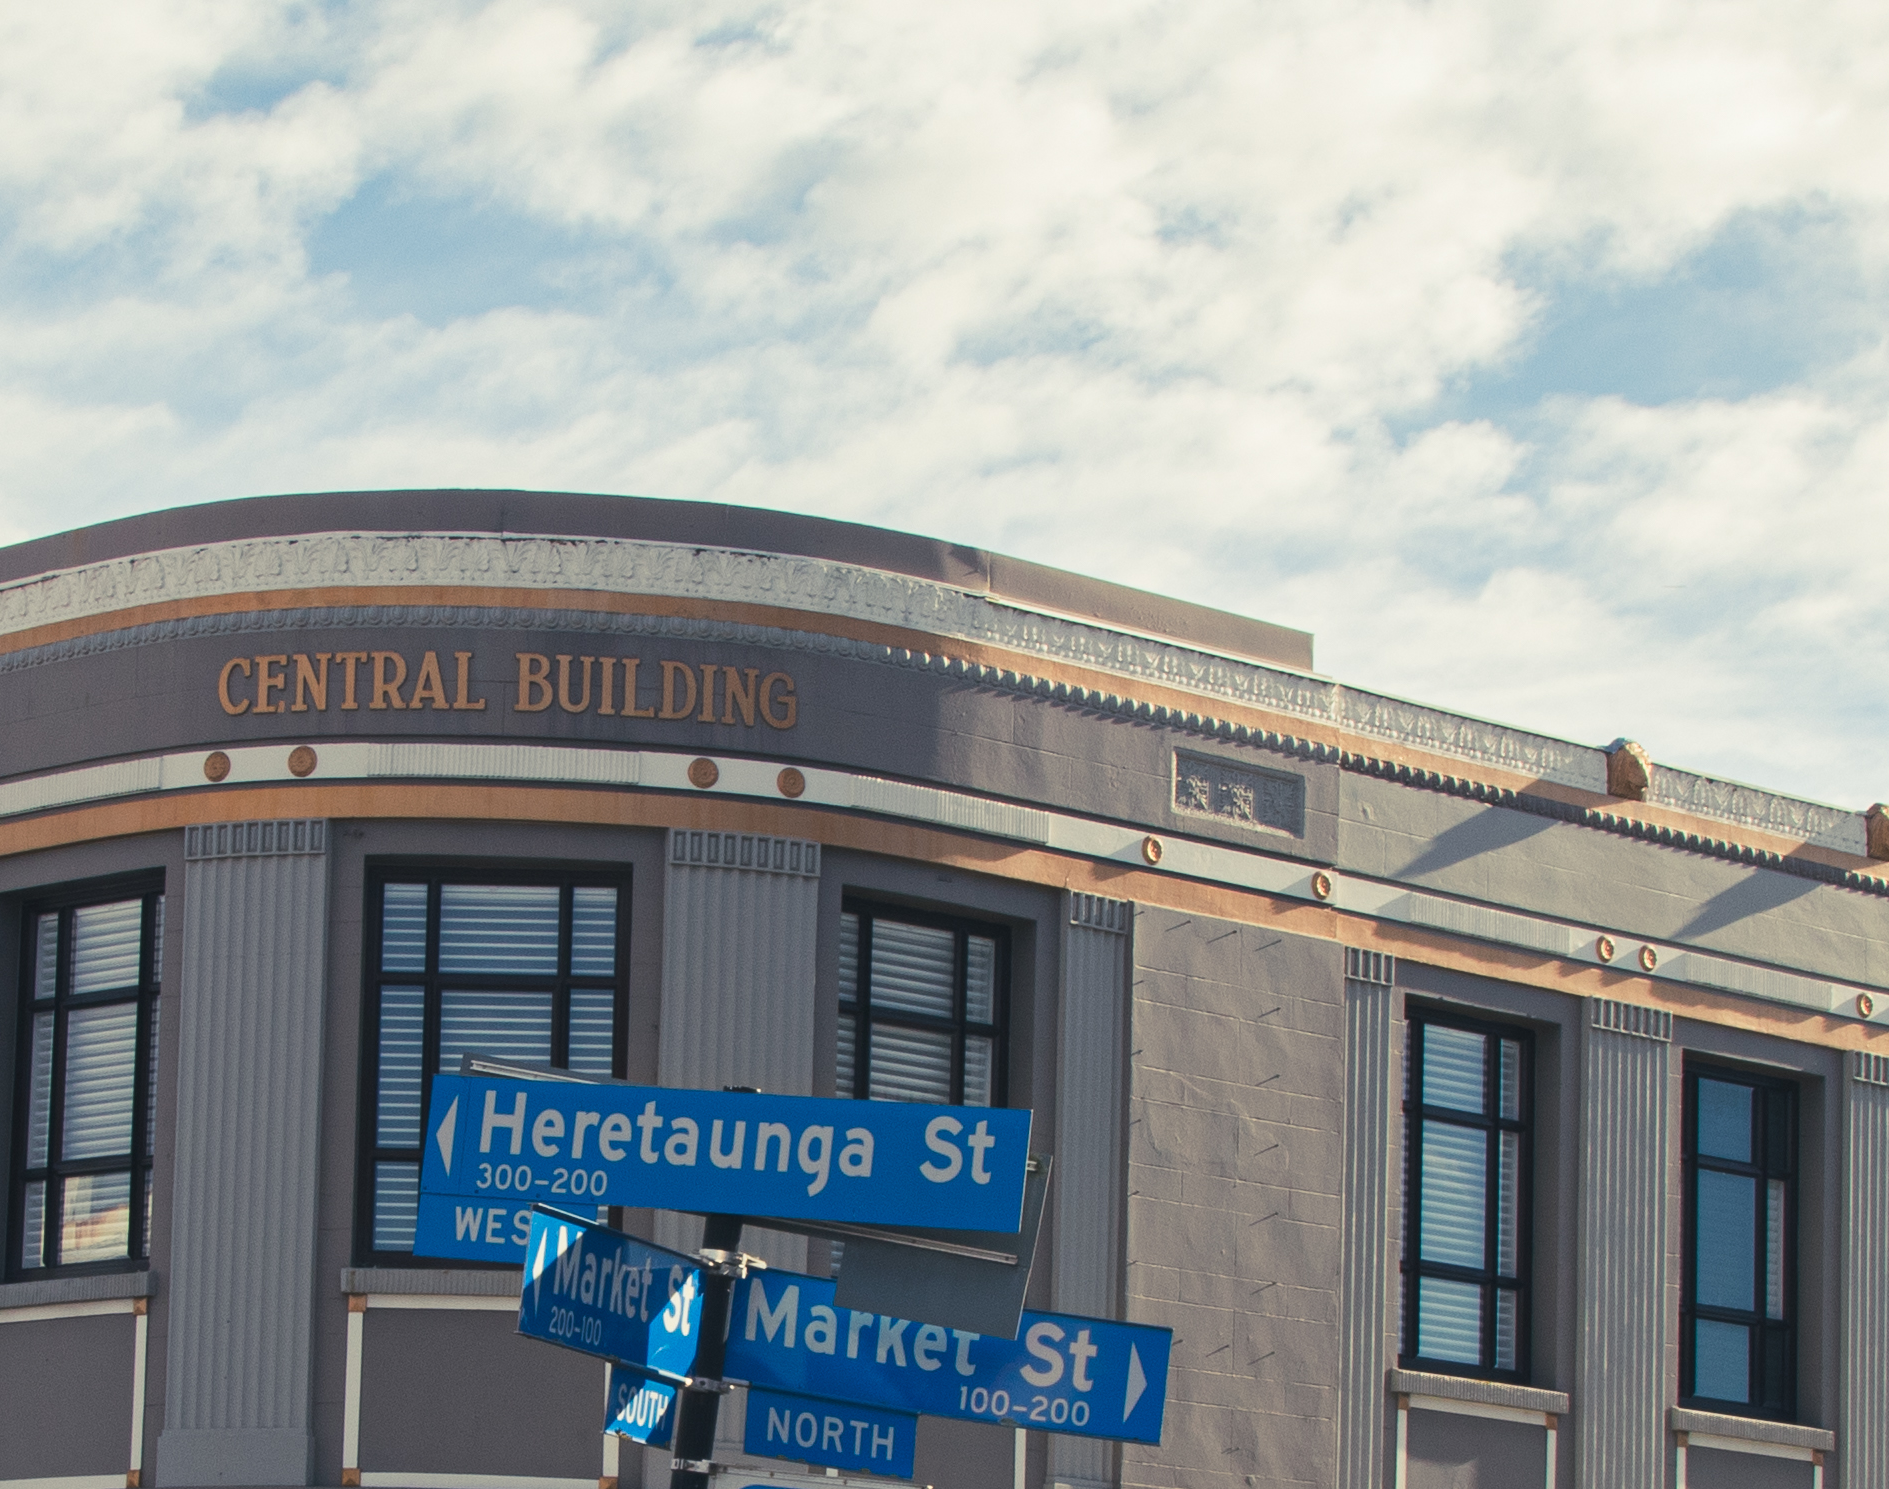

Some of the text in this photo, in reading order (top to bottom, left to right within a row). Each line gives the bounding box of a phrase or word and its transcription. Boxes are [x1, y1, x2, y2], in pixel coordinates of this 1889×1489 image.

[218, 650, 798, 730] CENTRAL BUILDING
[479, 1089, 996, 1197] Heretaunga St
[475, 1162, 608, 1197] 300-200
[454, 1206, 531, 1245] WES
[552, 1225, 696, 1337] Market St
[548, 1305, 602, 1346] 200-100
[744, 1277, 1098, 1393] Market St
[616, 1383, 670, 1431] SOUTH
[959, 1385, 1091, 1427] 100-200
[766, 1406, 895, 1461] NORTH
